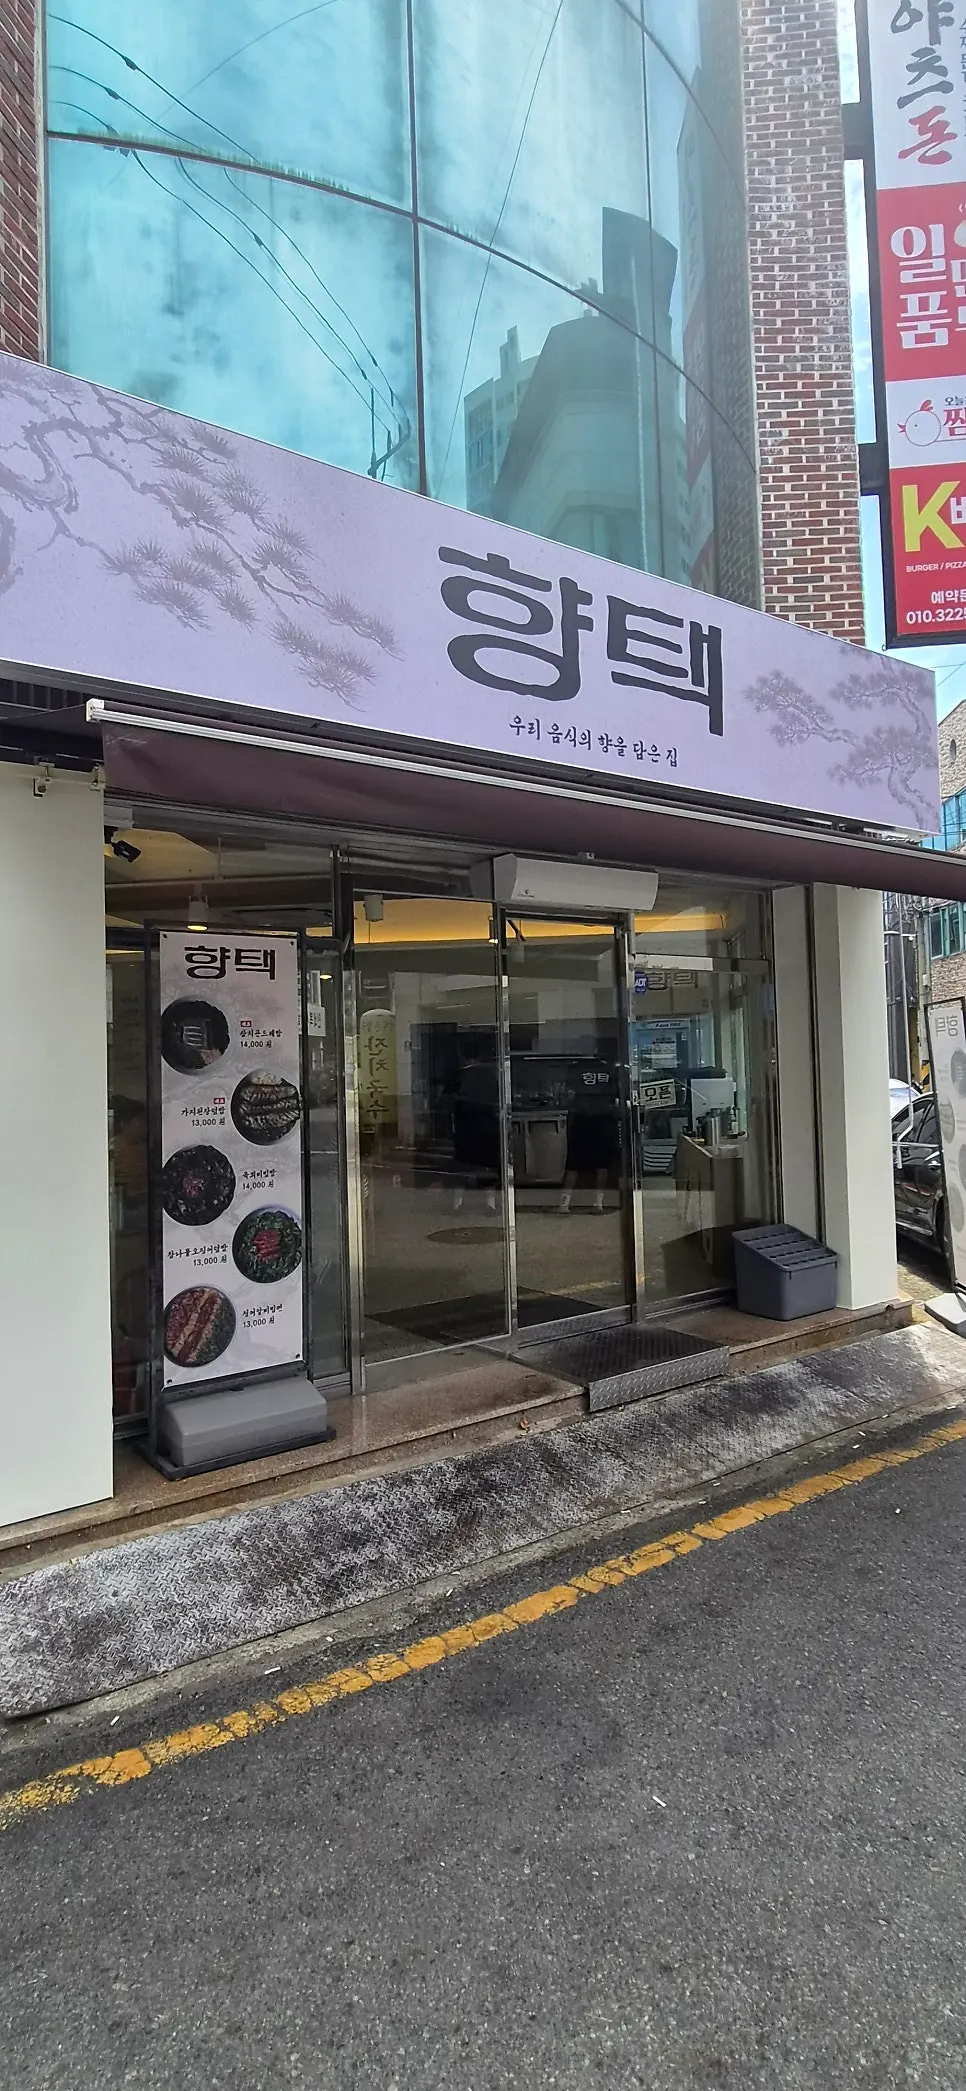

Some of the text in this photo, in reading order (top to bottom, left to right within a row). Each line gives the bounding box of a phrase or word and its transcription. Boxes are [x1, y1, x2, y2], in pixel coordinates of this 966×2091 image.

[889, 223, 953, 349] 일품
[945, 396, 966, 406] 오늘
[906, 564, 939, 573] BURGER
[438, 546, 724, 736] 향택
[509, 715, 678, 768] 우리 음식의 향을 담은 집
[183, 945, 276, 980] 향택
[634, 978, 647, 987] ADT
[240, 1041, 264, 1049] 14,000
[191, 1118, 217, 1127] 13,000
[243, 1181, 266, 1190] 14,000
[193, 1257, 218, 1267] 13,000
[243, 1318, 266, 1328] 13,000
